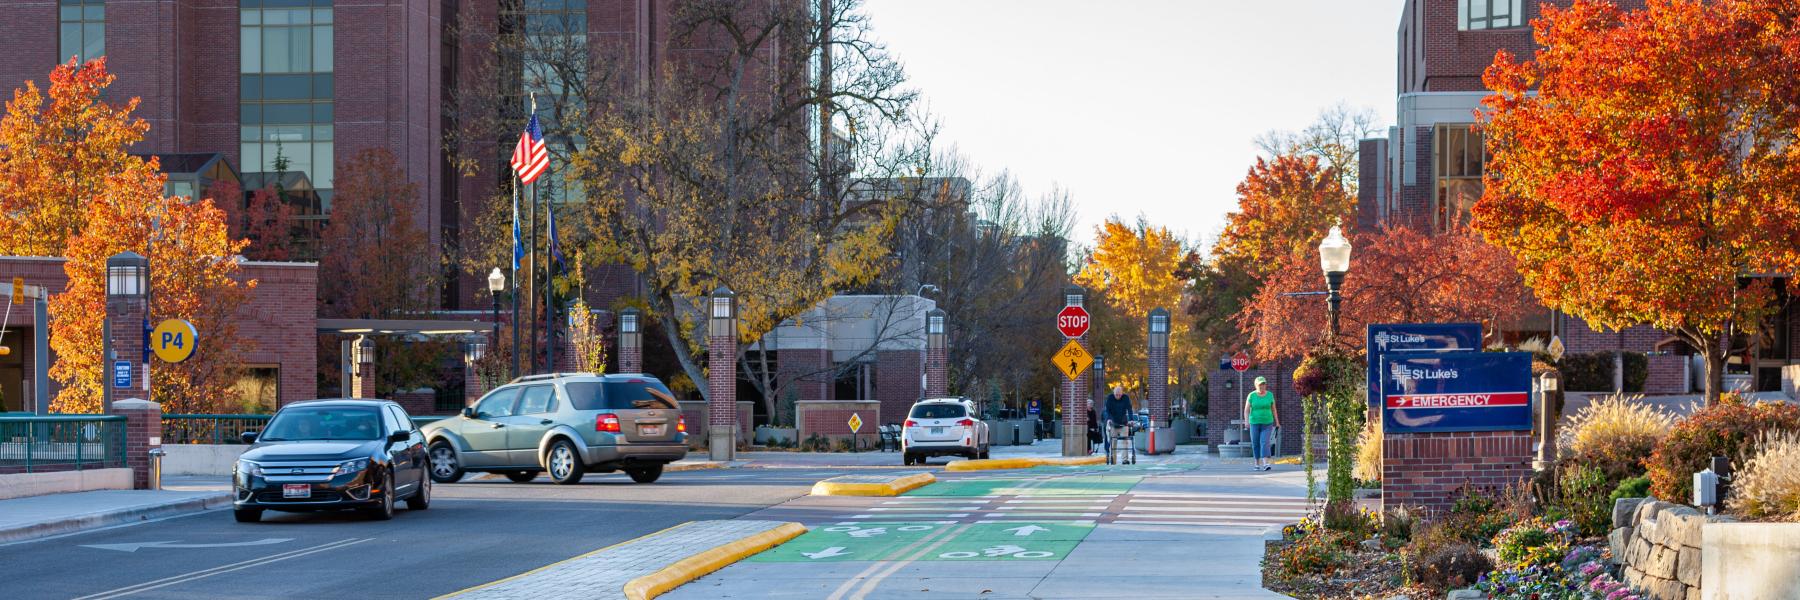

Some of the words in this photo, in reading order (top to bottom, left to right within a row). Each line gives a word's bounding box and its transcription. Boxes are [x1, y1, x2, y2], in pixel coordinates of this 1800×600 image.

[1060, 315, 1088, 328] STOP
[162, 332, 183, 349] P4
[1390, 335, 1399, 343] St
[1400, 334, 1425, 343] Luke's
[1412, 369, 1424, 379] St
[1425, 368, 1458, 379] Luke's
[1412, 394, 1491, 407] EMERGENCY
